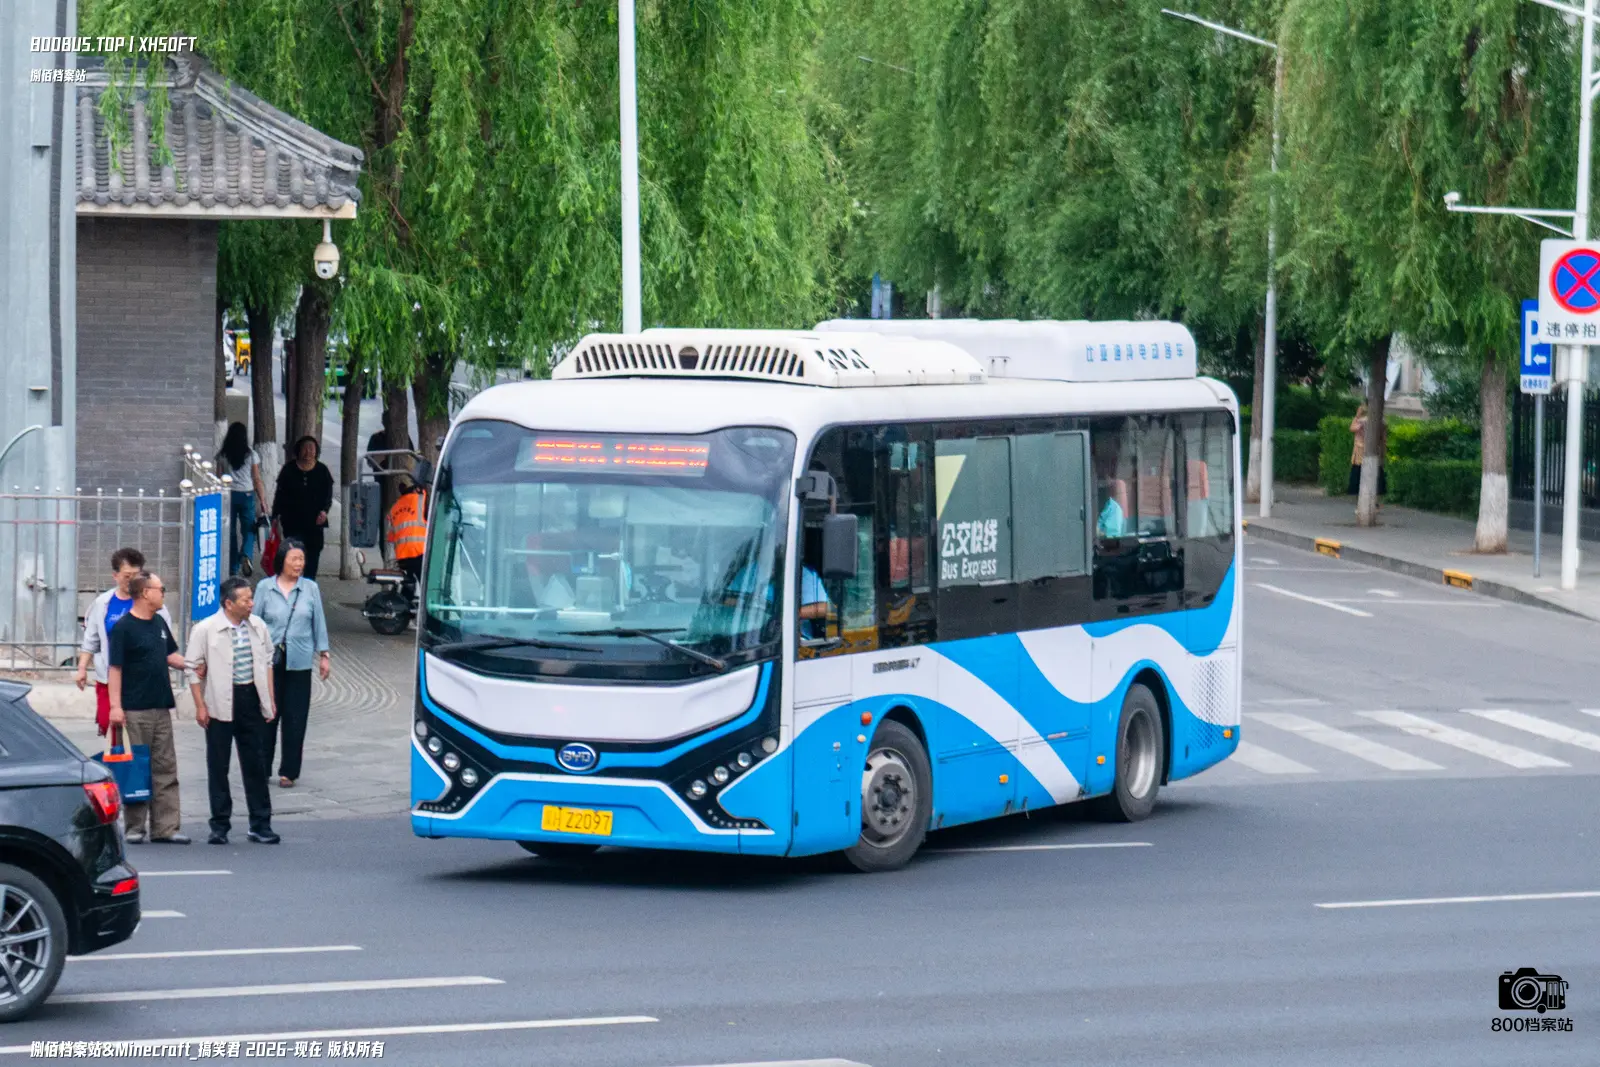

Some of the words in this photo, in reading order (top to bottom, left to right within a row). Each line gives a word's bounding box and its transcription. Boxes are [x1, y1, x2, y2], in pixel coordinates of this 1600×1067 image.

[941, 519, 998, 557] 公交快线
[941, 560, 958, 580] Bus
[962, 558, 997, 579] Express
[563, 750, 591, 762] BYD
[566, 811, 610, 831] Z2097
